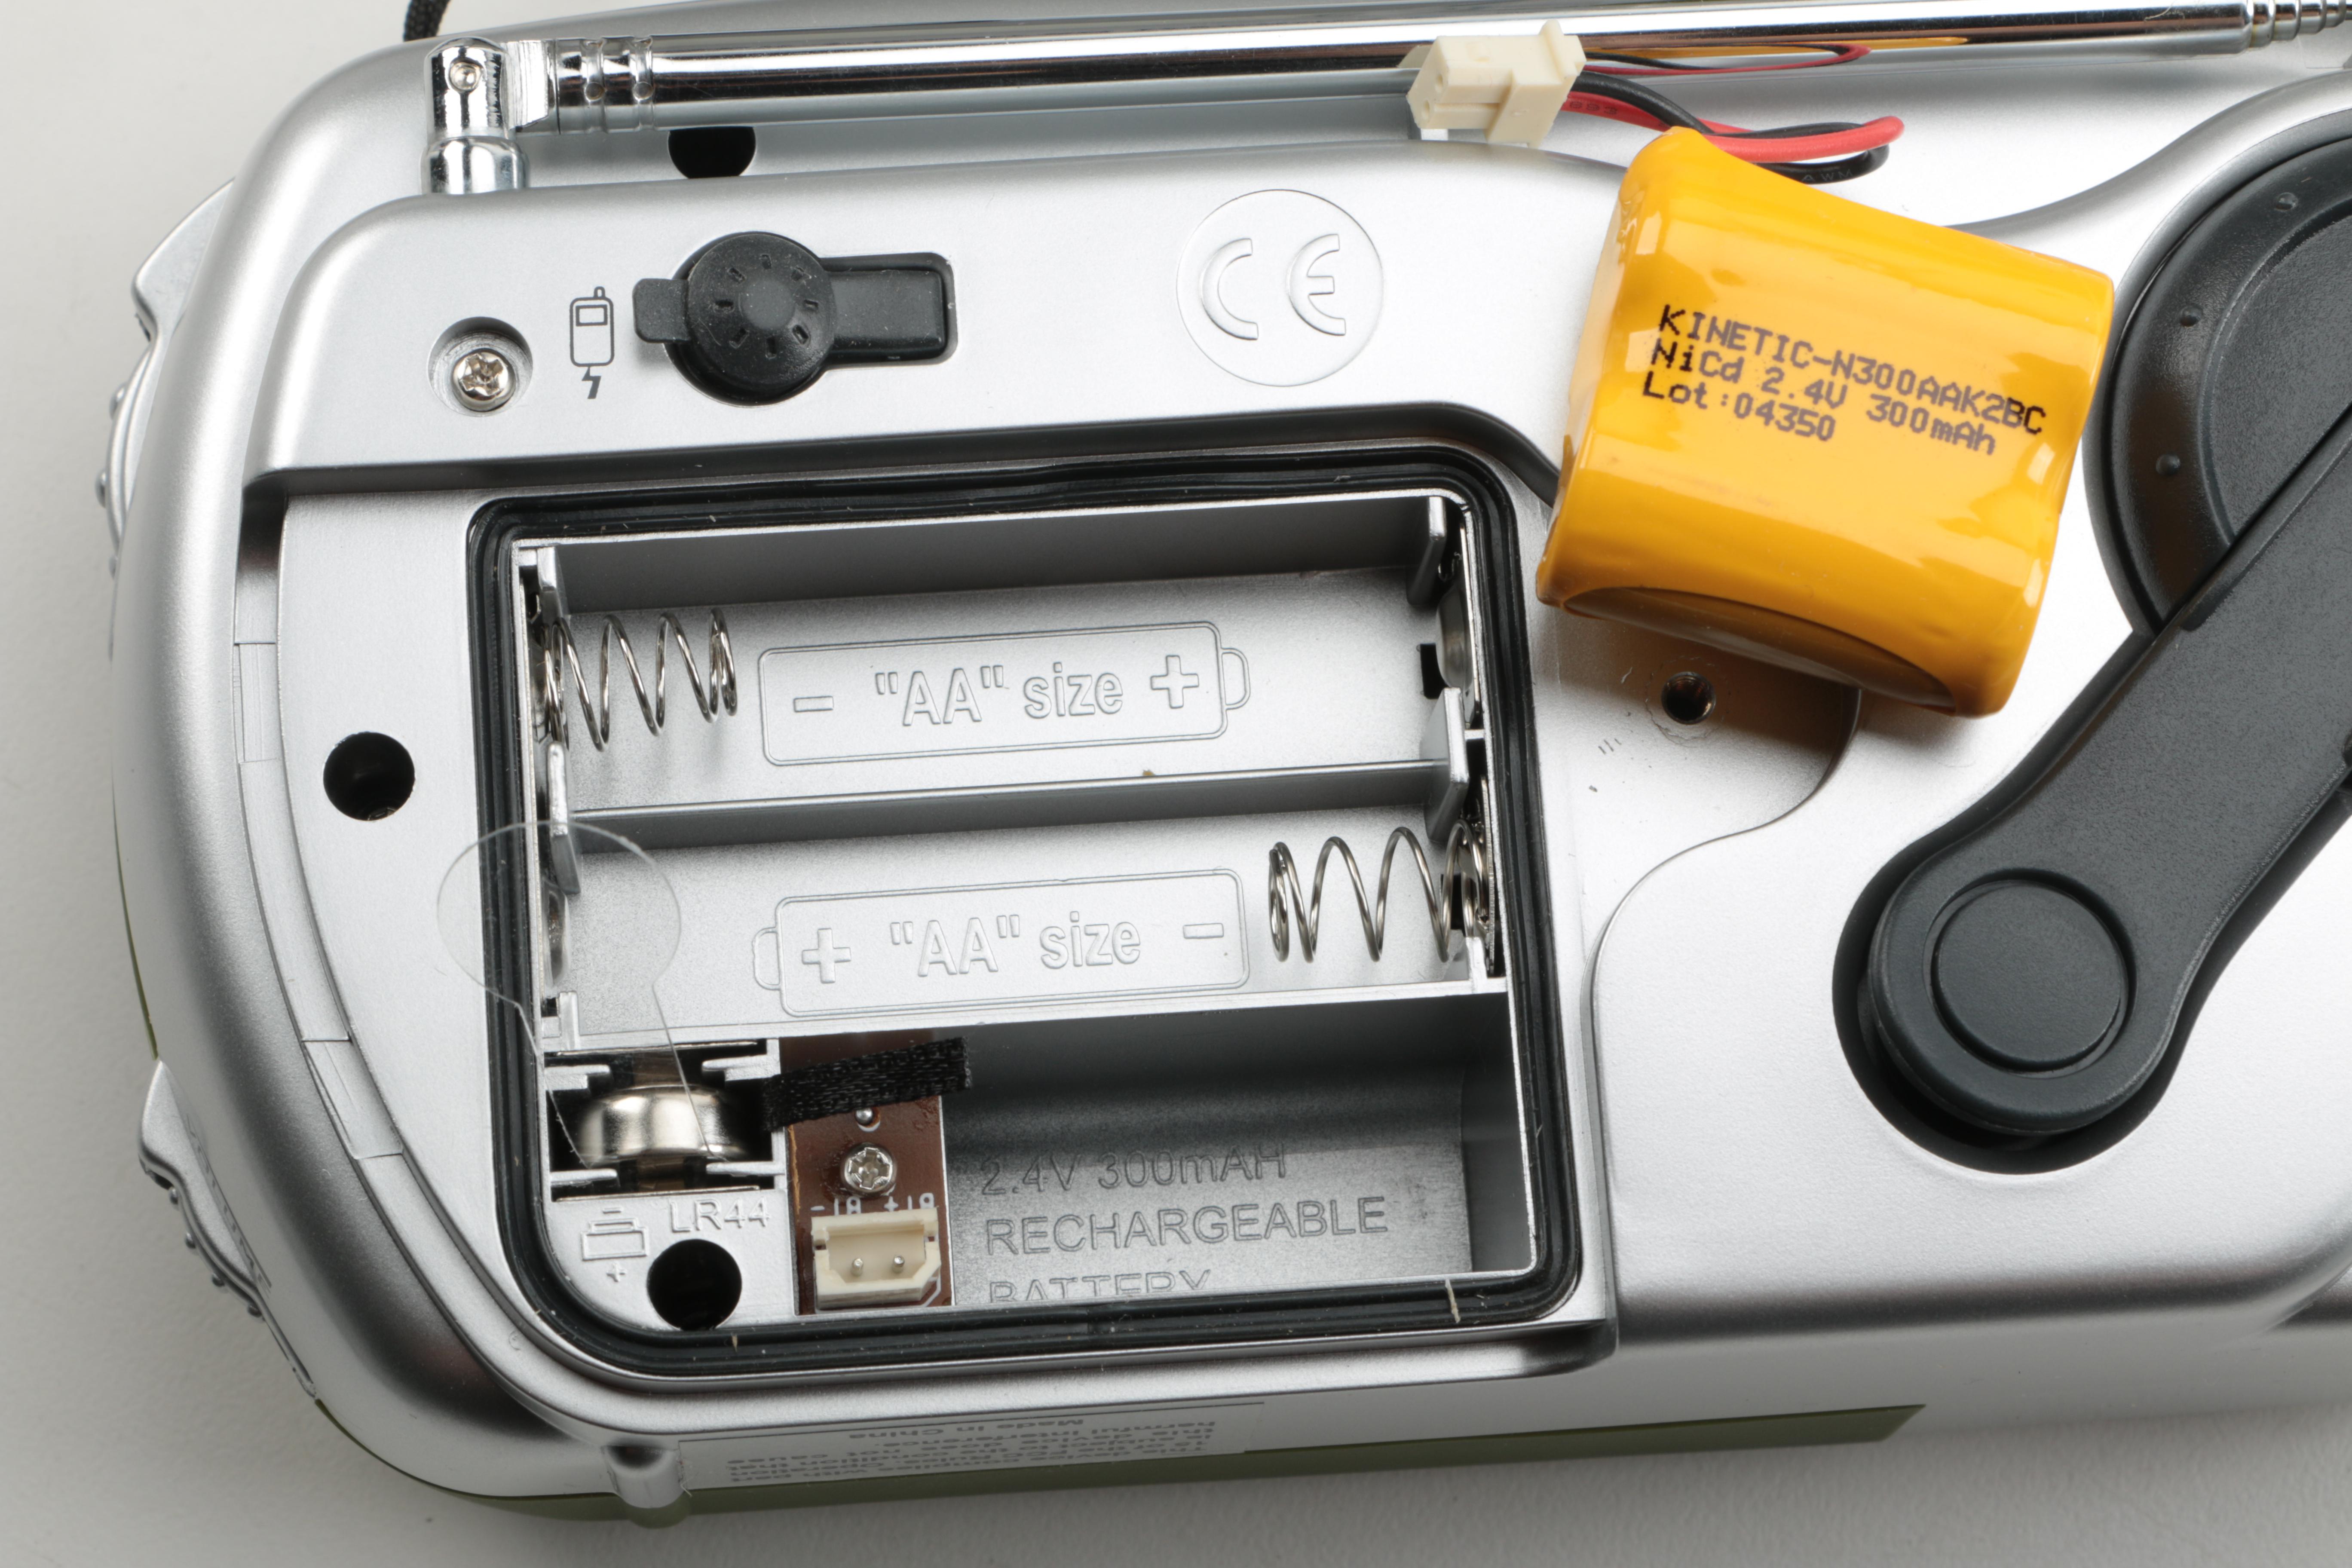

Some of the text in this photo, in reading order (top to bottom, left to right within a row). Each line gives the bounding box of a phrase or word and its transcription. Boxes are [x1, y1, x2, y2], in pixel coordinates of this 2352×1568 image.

[1801, 171, 1853, 182] AWM
[1199, 233, 1346, 340] CE
[1651, 338, 1995, 455] NiCd 2.4V 300mAh
[1659, 304, 2046, 435] KINETIC-N300AAK2BC
[1643, 372, 1835, 441] Lot:04350
[875, 662, 1123, 726] "AA" size
[890, 911, 1141, 977] "AA" size
[980, 1142, 1286, 1196] 2.4V 300mAH
[671, 1197, 770, 1233] LR44
[986, 1195, 1388, 1255] RECHARGEABLE
